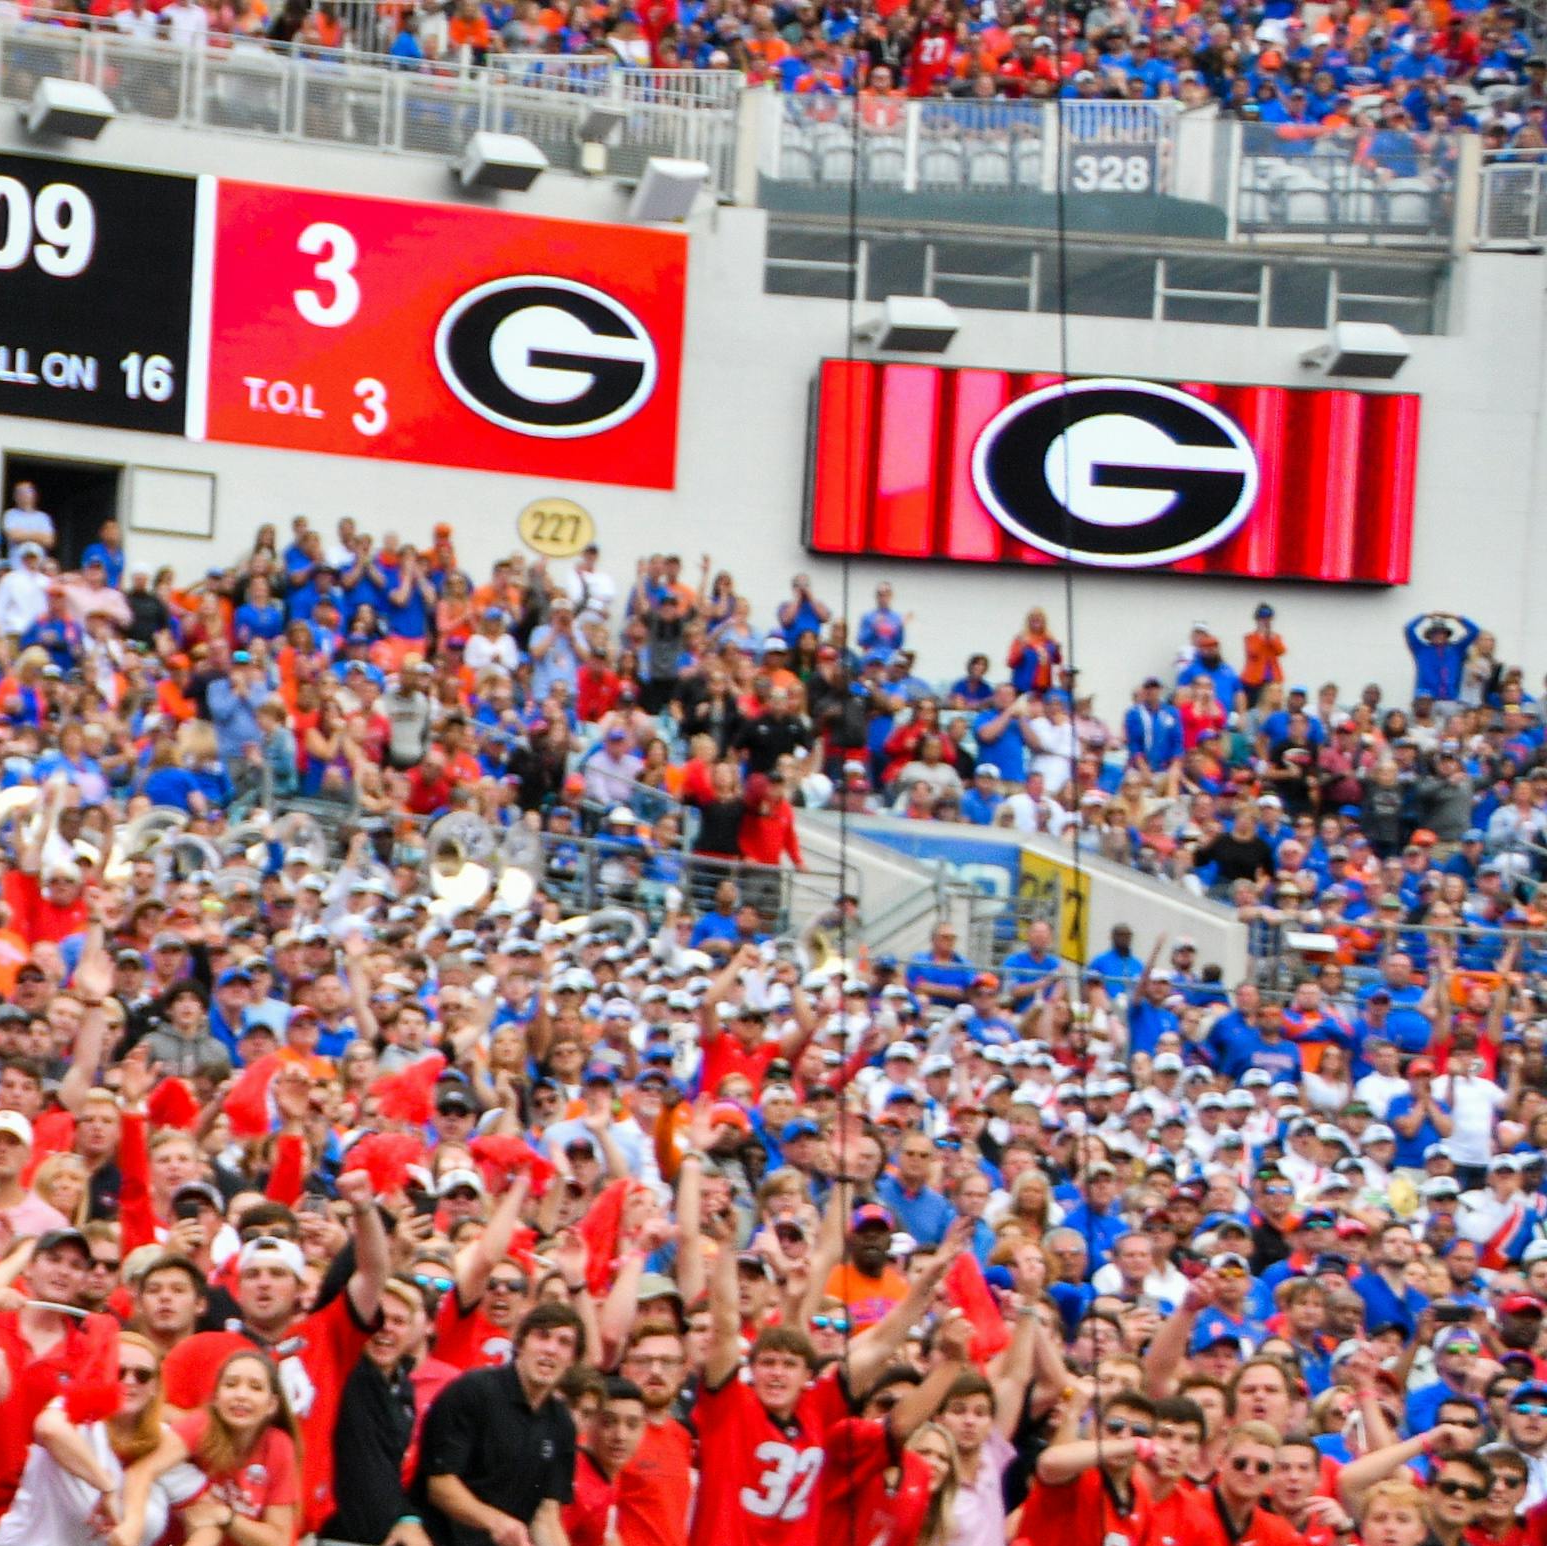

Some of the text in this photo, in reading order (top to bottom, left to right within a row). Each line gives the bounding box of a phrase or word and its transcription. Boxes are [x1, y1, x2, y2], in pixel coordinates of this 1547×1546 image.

[1073, 154, 1150, 193] 328
[293, 222, 361, 328] 3
[41, 351, 98, 392] ON
[120, 351, 174, 402] 16
[352, 377, 388, 437] 3
[530, 510, 583, 545] 227
[739, 1440, 825, 1521] 32
